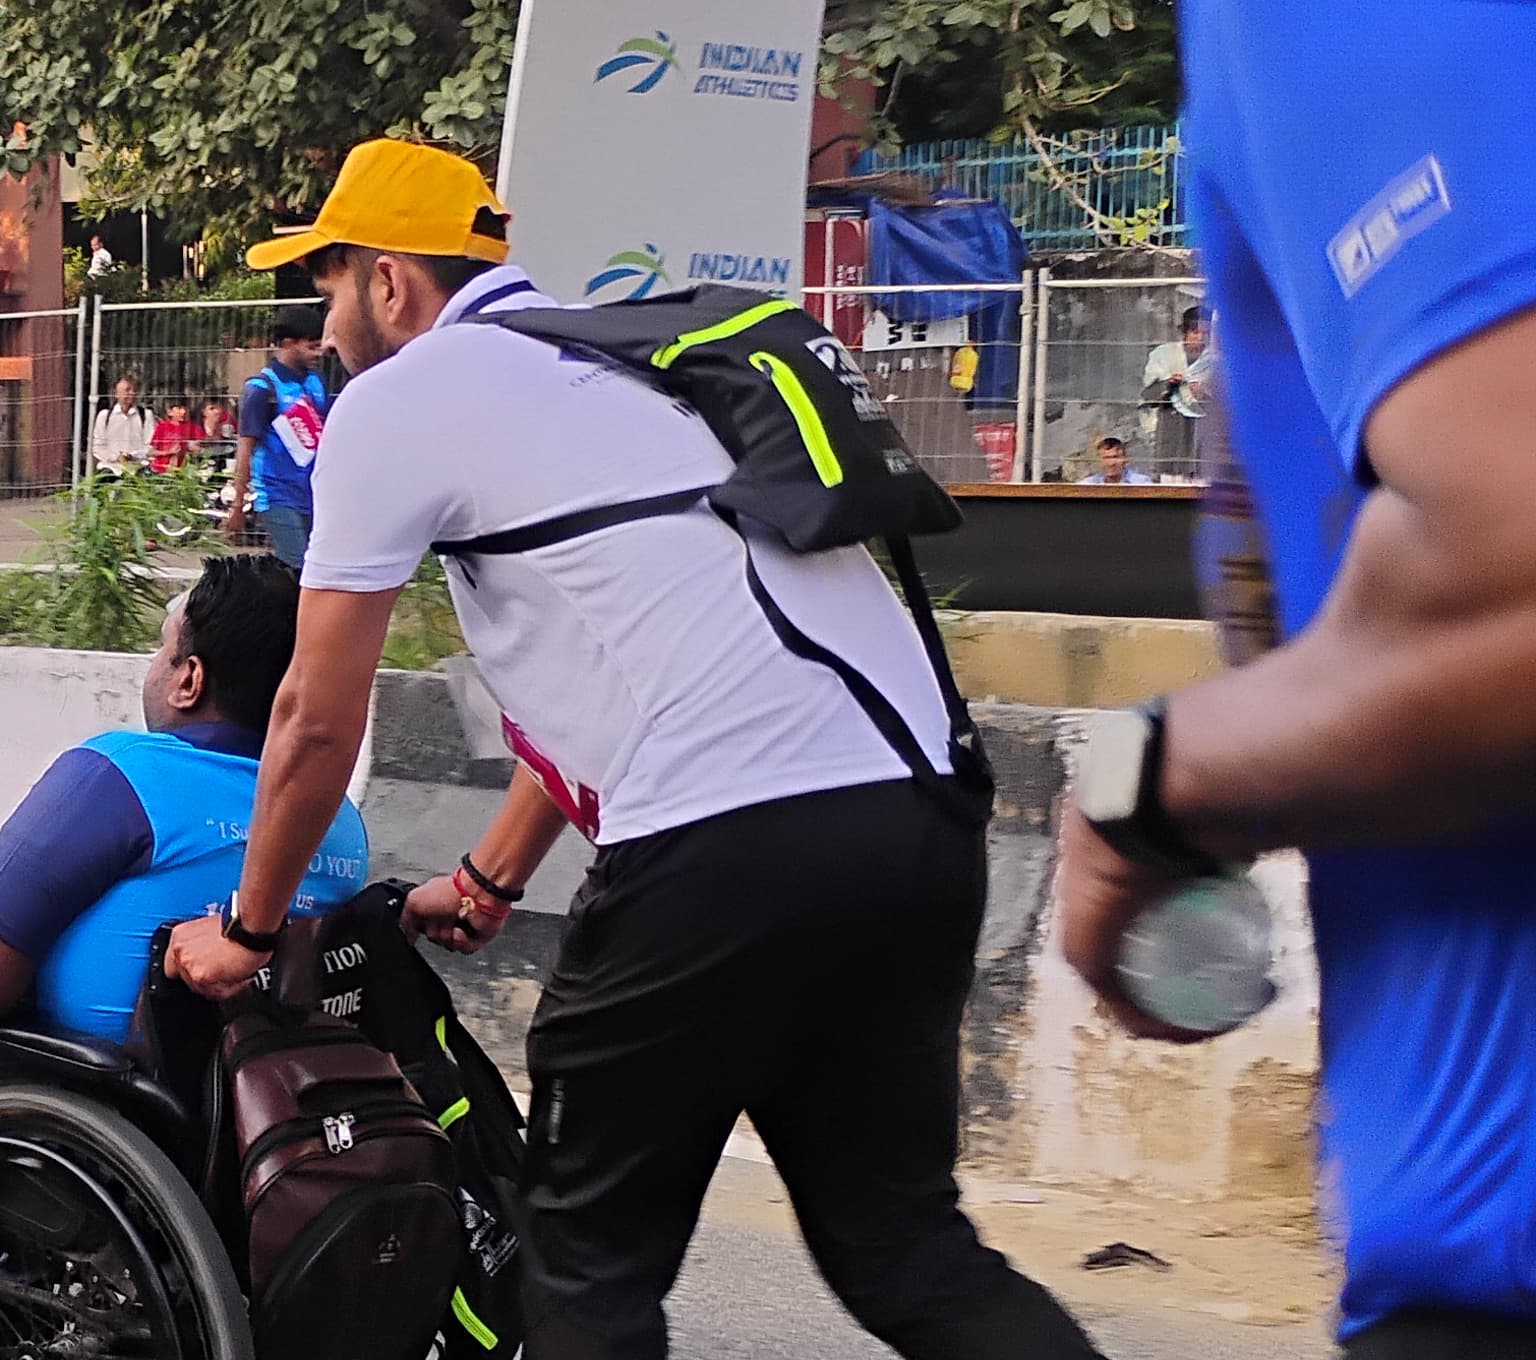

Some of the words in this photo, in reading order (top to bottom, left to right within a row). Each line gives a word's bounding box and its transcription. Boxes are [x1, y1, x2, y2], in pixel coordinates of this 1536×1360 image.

[698, 42, 802, 77] INDIAN
[693, 75, 798, 101] ATHLETICS
[687, 252, 791, 283] INDIAN
